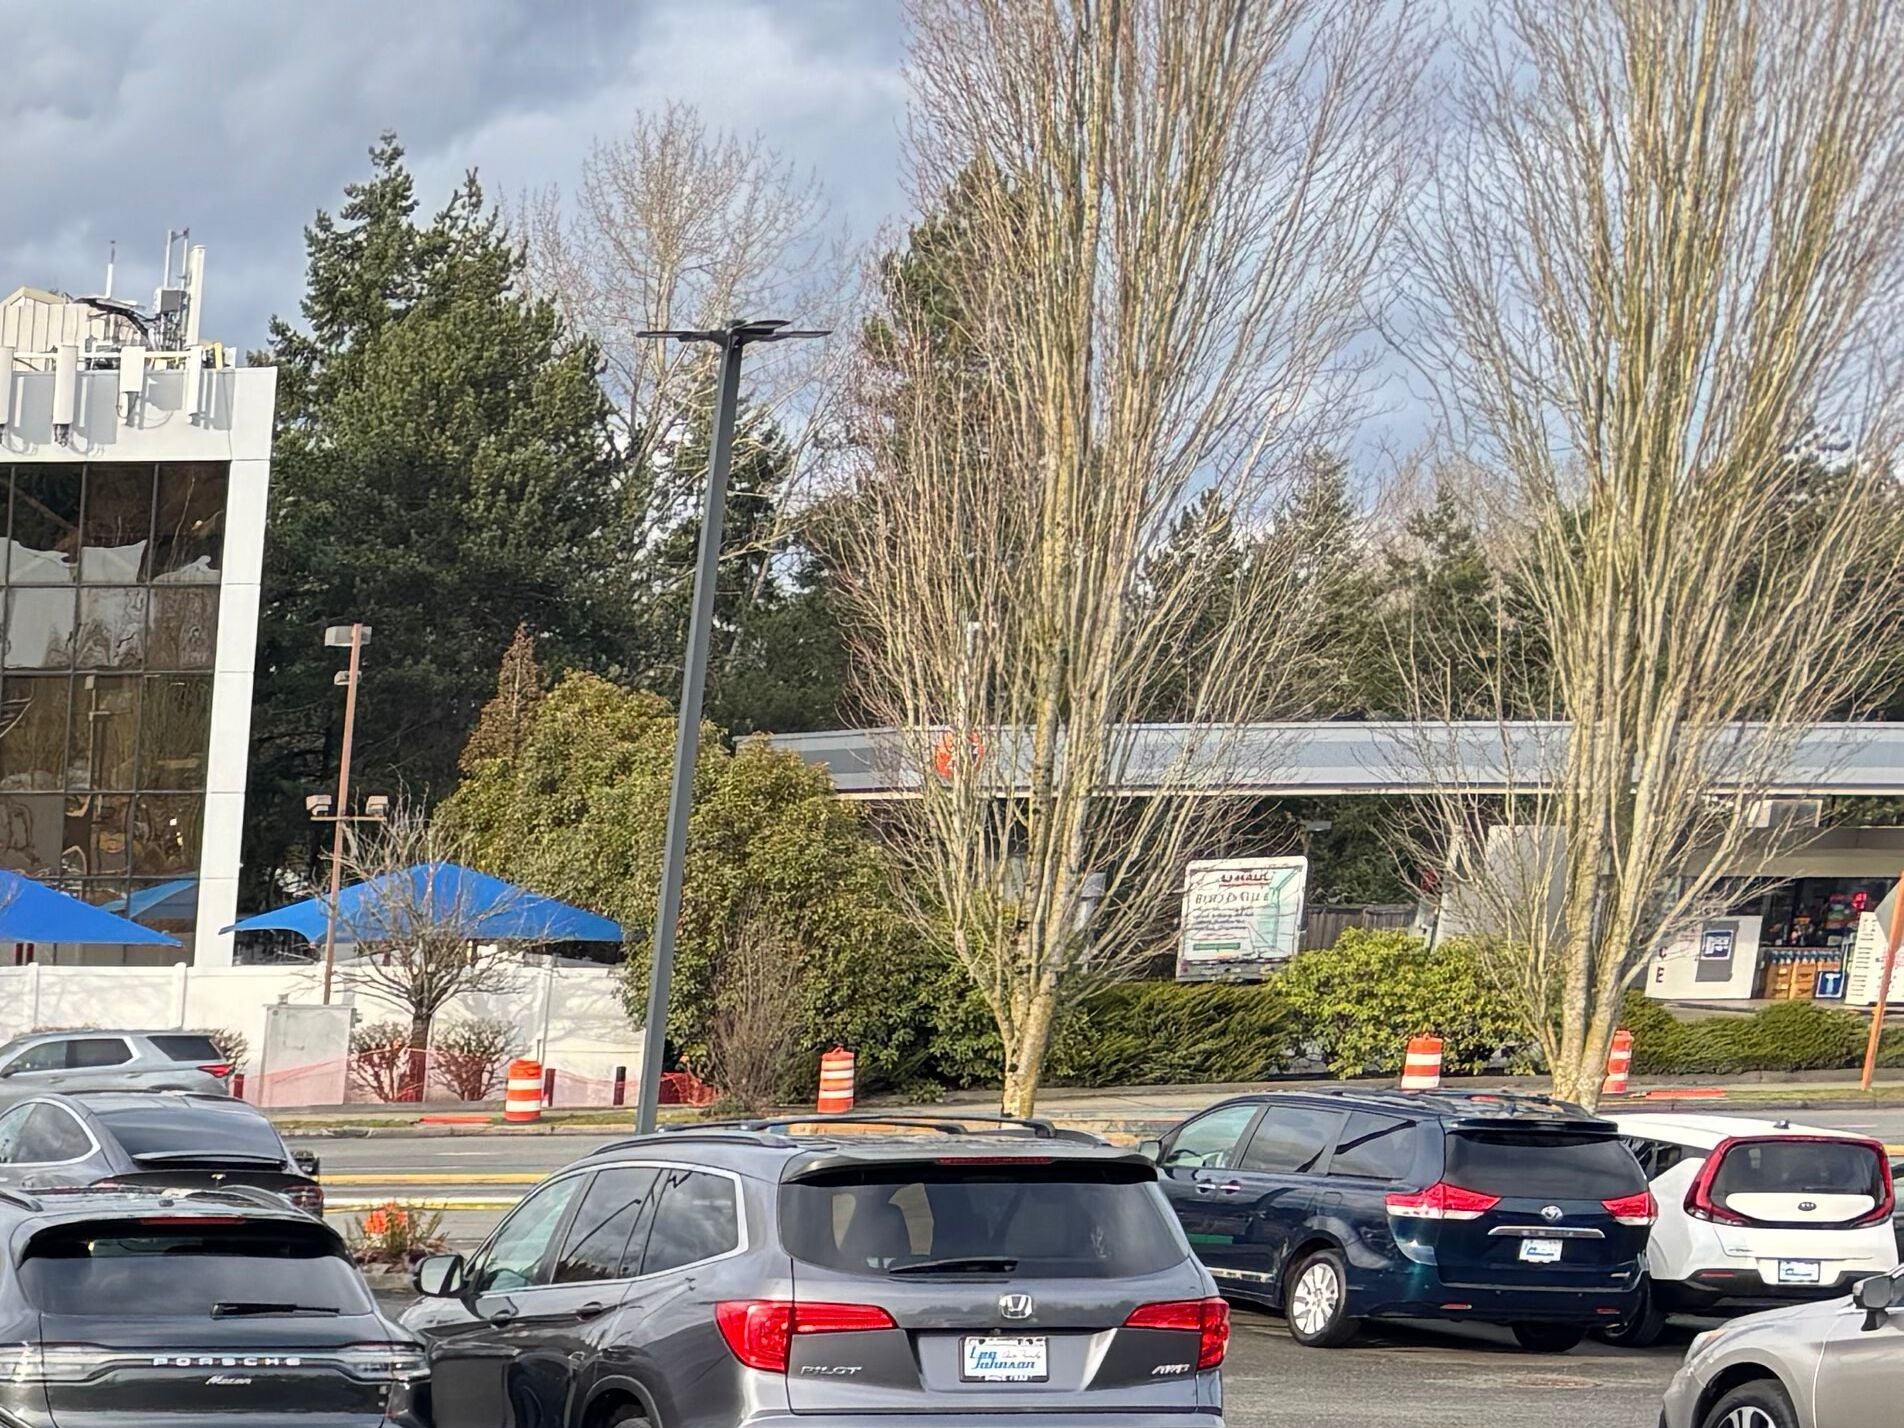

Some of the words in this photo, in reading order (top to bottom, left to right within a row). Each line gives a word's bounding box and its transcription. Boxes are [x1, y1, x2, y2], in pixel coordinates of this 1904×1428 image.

[152, 1357, 302, 1367] PORSCHE
[800, 1365, 863, 1377] PILOT
[205, 1375, 252, 1385] Macan
